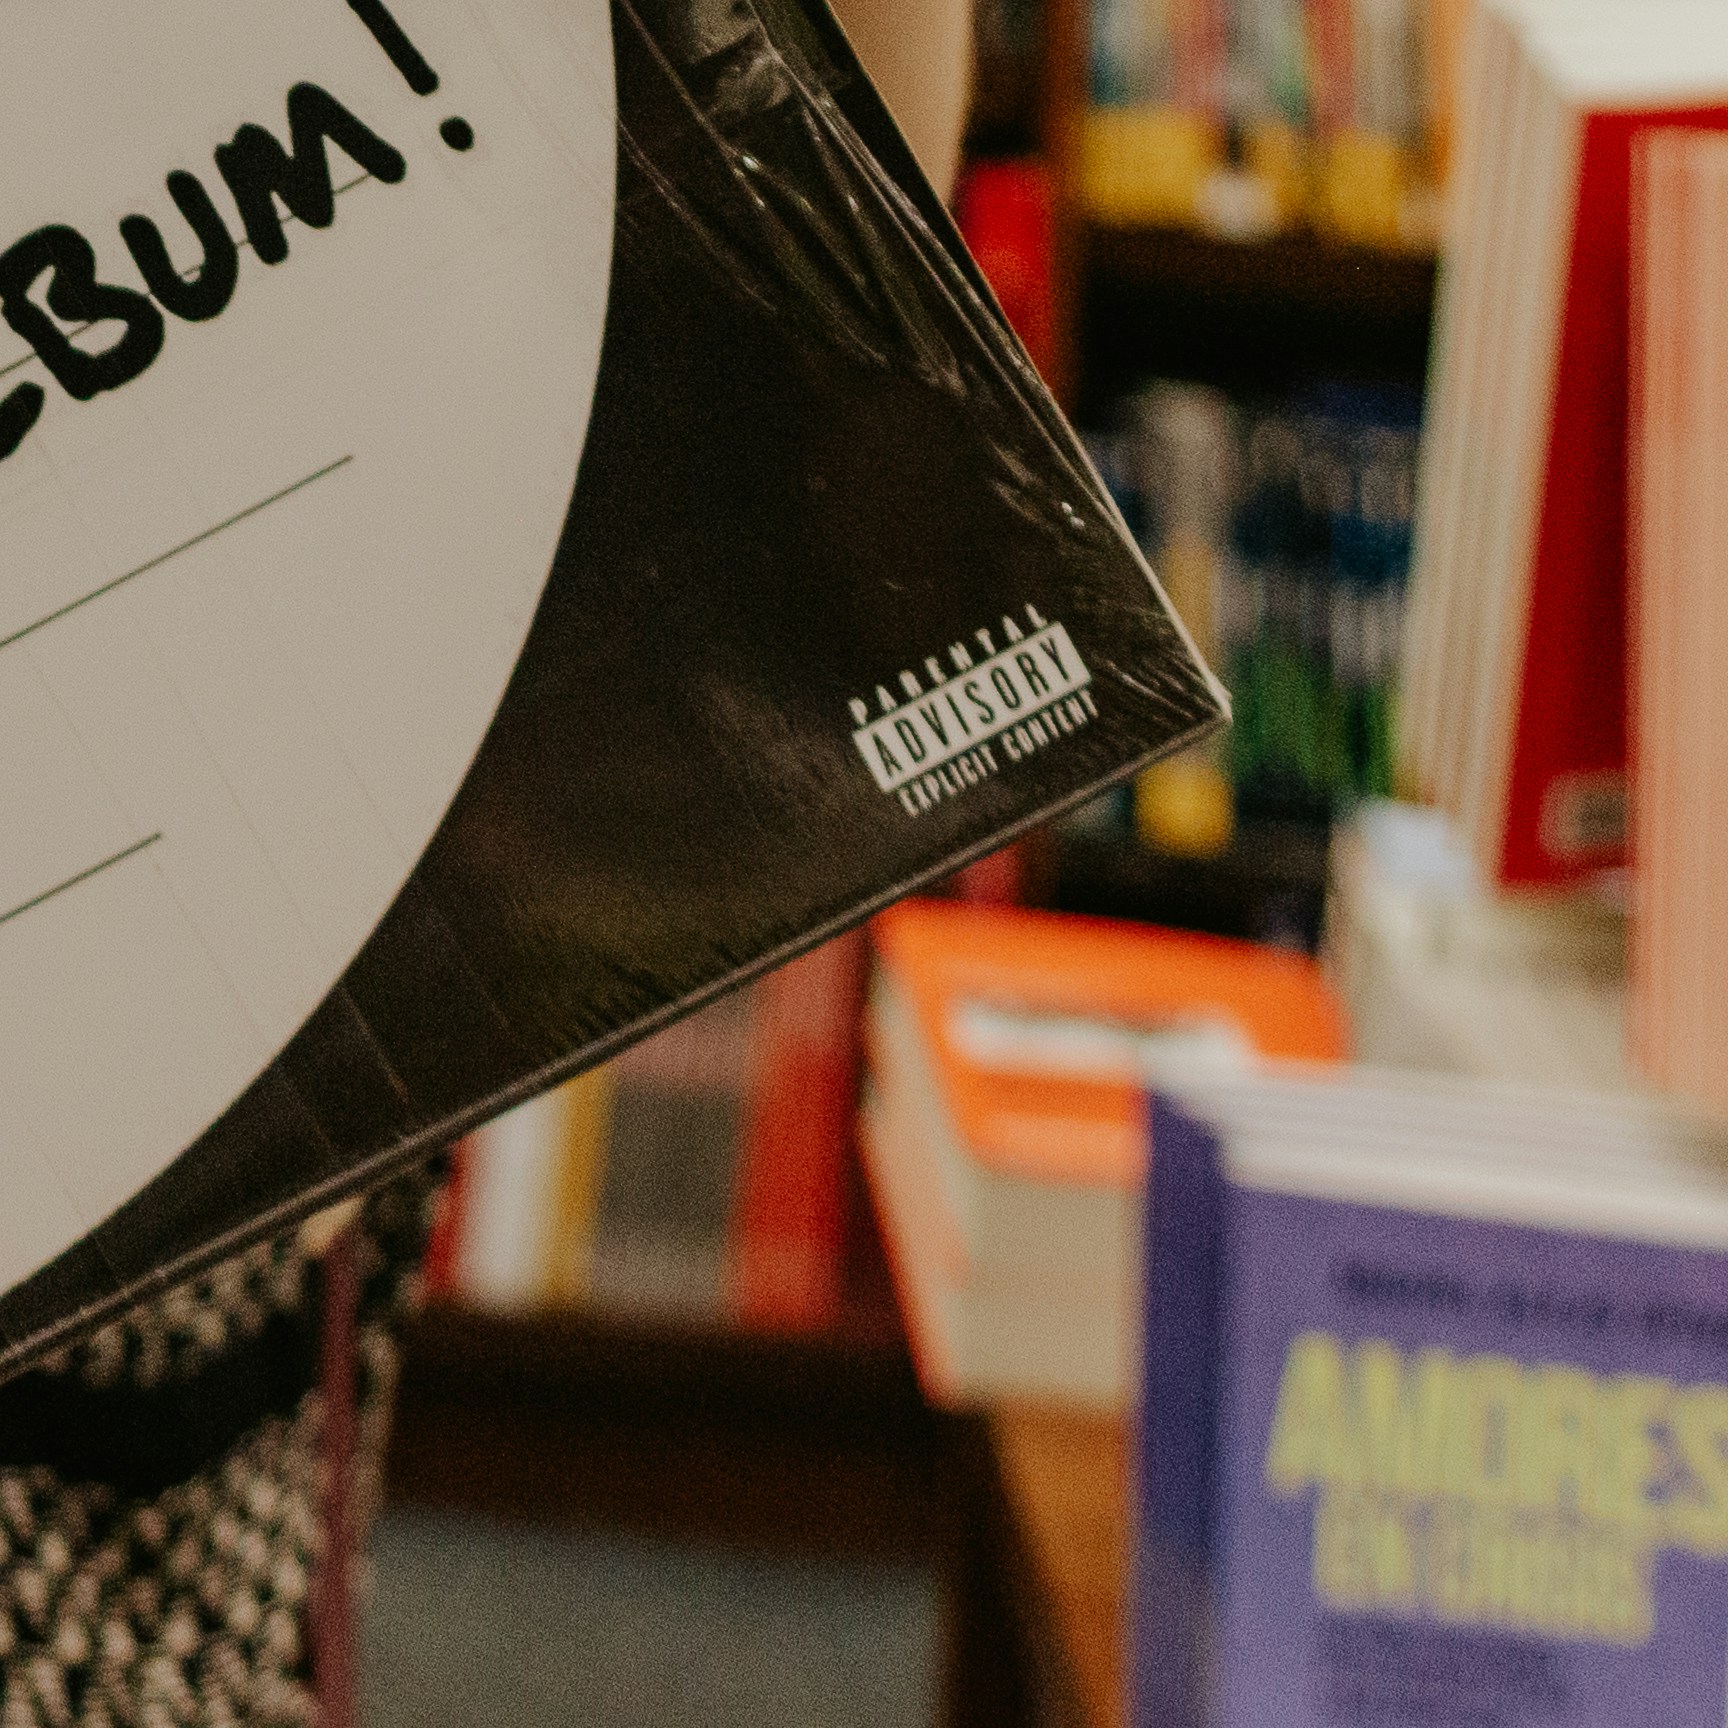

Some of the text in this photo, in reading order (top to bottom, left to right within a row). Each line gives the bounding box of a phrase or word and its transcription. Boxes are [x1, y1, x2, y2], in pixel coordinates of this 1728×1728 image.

[848, 602, 1047, 726] PARENTAL
[869, 634, 1072, 779] ADVISORY
[898, 686, 1099, 819] EXPLICIT CONTENT
[1266, 1329, 1728, 1560] AMORES
